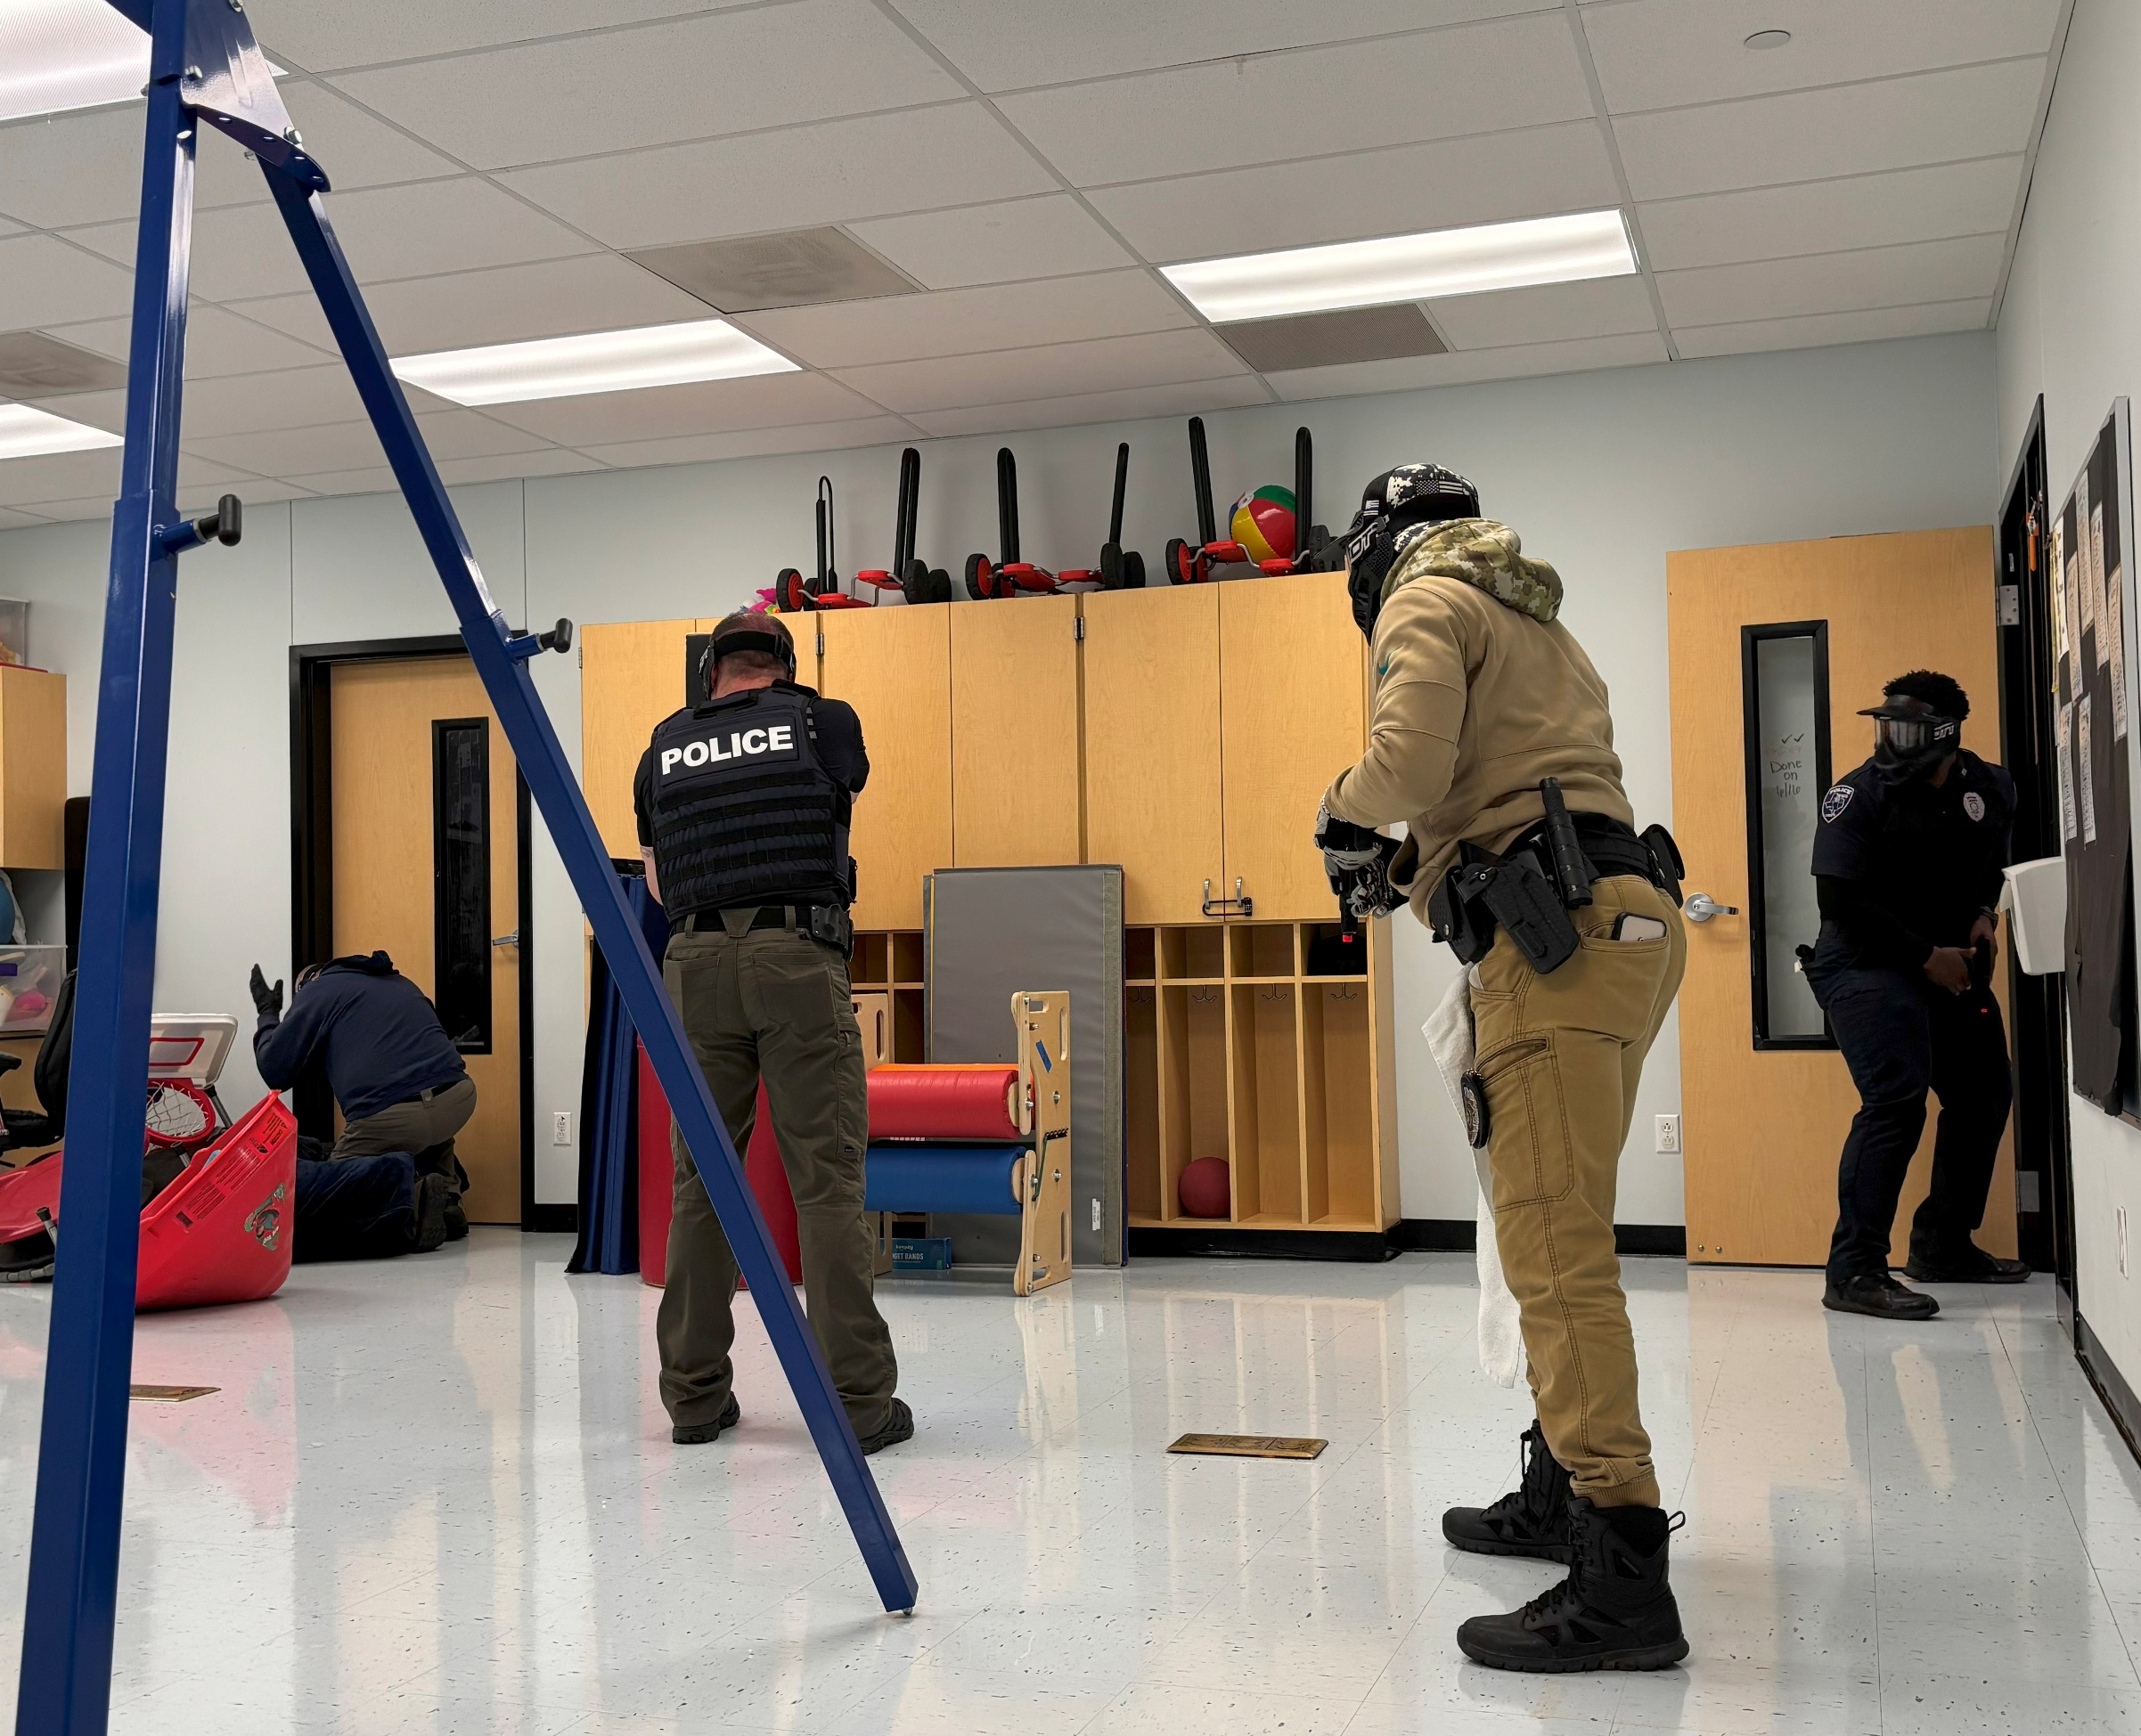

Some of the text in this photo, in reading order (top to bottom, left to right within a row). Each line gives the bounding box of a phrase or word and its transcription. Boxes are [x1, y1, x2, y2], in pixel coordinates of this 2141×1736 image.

[661, 725, 794, 776] POLICE
[1769, 760, 1802, 774] Done
[1783, 771, 1798, 781] on
[904, 1252, 924, 1260] BANDS
